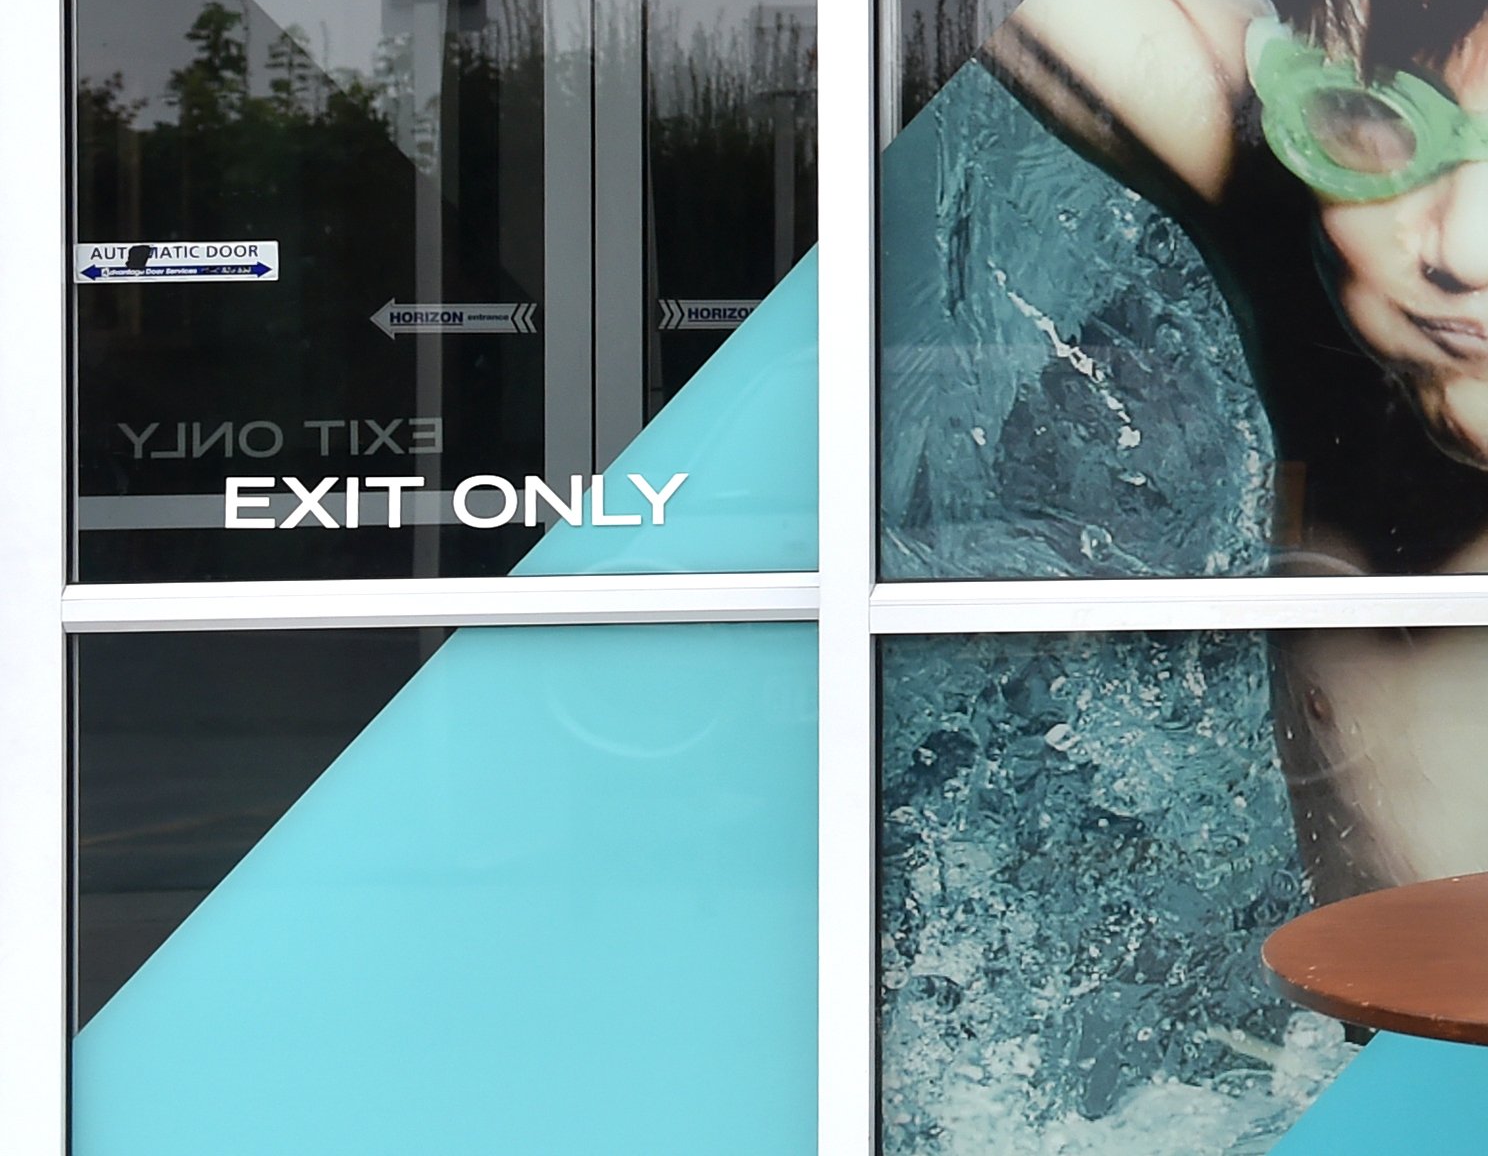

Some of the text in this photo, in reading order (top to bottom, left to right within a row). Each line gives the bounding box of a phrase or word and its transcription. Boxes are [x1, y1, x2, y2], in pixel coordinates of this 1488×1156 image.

[90, 245, 259, 260] AUTMATIC DOOR
[389, 311, 509, 324] HORIZON entrance
[688, 307, 755, 319] HORIZO
[224, 473, 689, 529] EXIT ONLY
